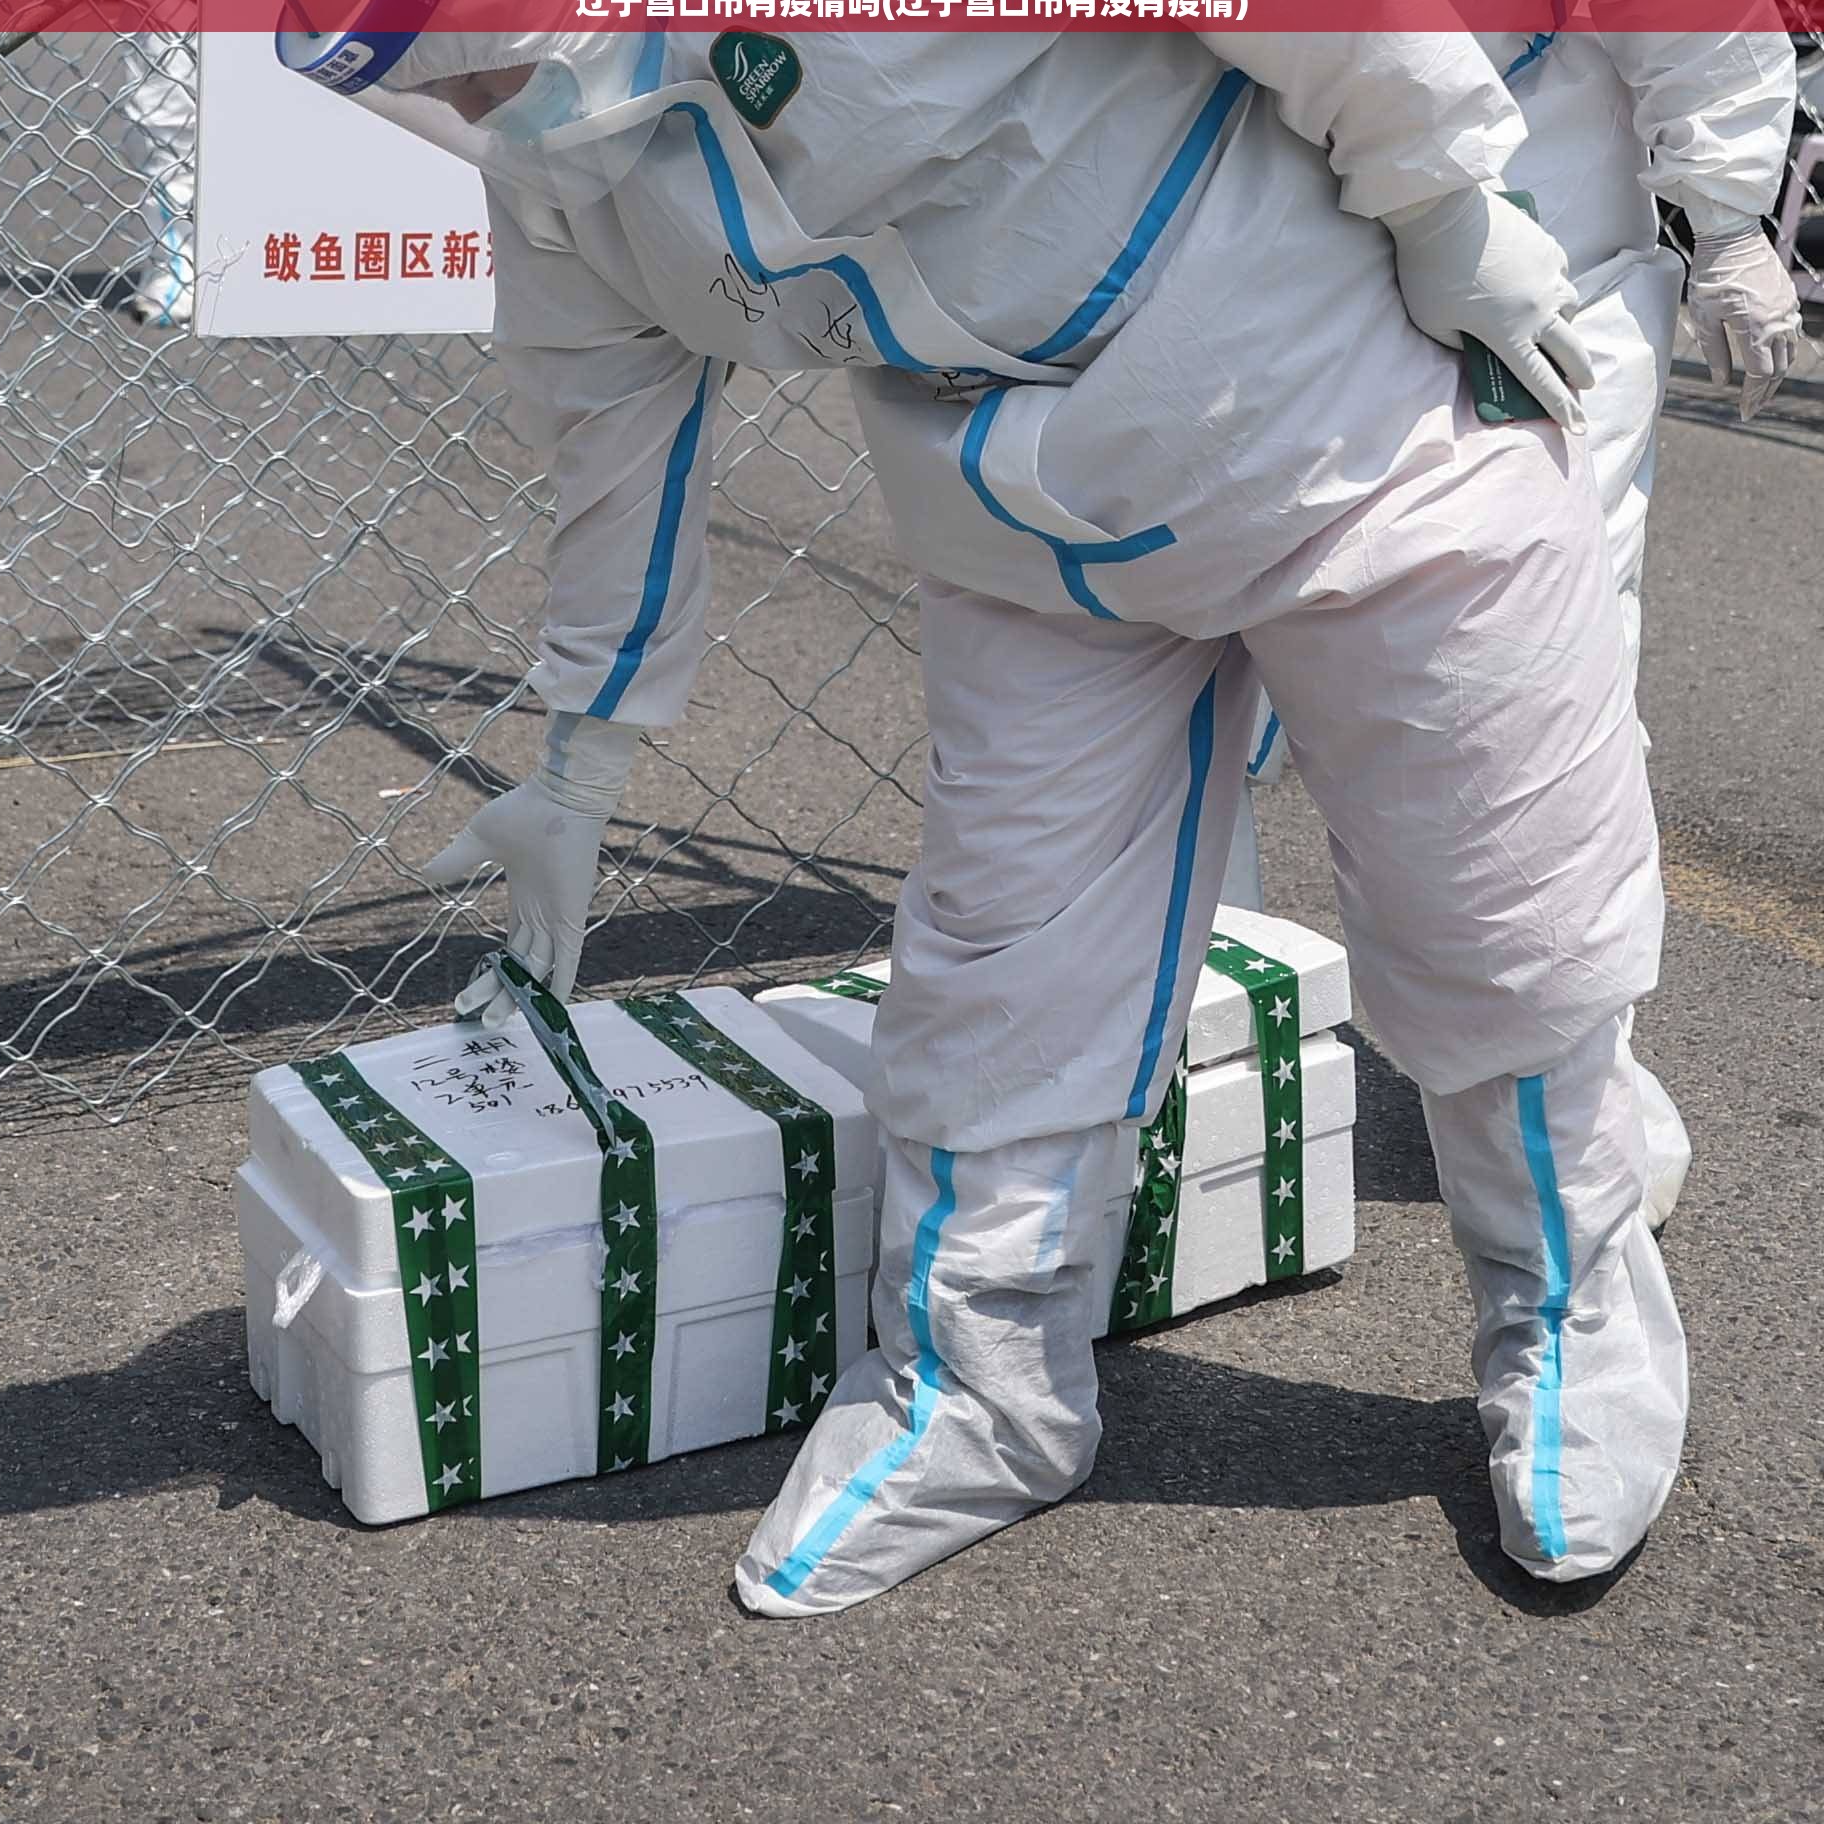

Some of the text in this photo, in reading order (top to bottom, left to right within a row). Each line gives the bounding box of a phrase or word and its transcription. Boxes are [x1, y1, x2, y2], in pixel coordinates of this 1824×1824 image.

[739, 57, 769, 95] GREEN
[746, 51, 787, 103] SPARROW
[264, 230, 496, 283] 鲅鱼圈区新
[468, 1093, 513, 1114] 501
